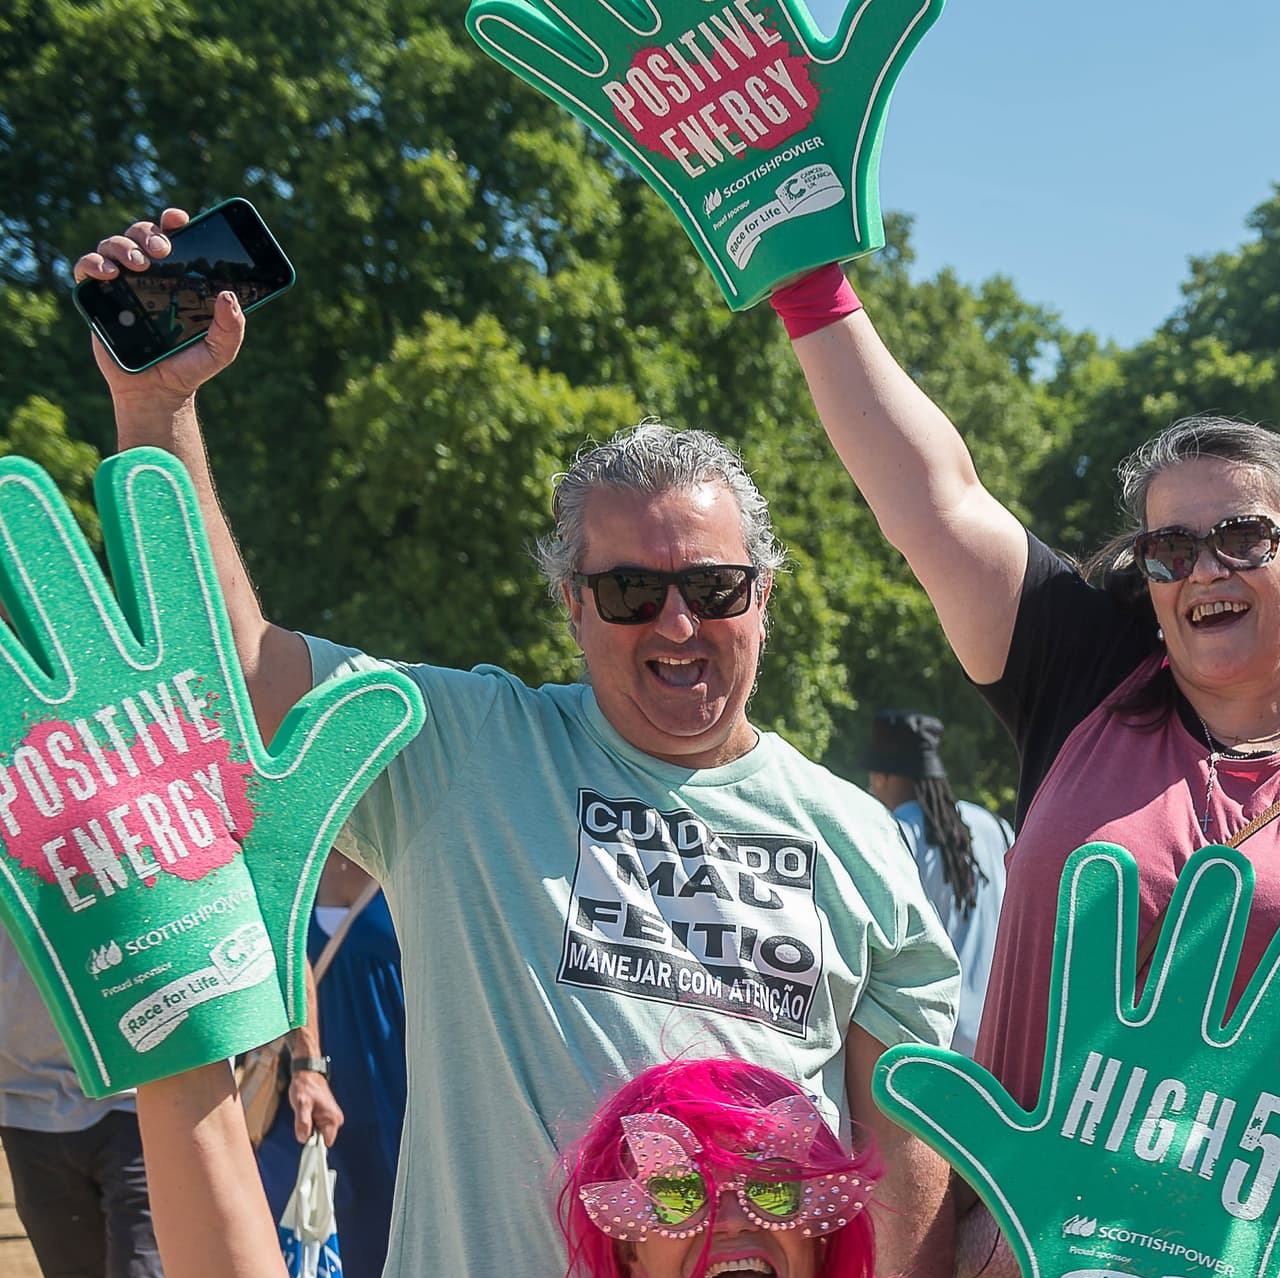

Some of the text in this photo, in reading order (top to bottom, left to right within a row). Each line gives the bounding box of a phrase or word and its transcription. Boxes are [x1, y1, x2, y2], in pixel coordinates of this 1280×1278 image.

[602, 0, 782, 132] POSITIVE
[659, 58, 808, 178] ENERGY
[723, 136, 825, 198] SCOTTISHPOWER
[729, 206, 782, 256] Race for Life
[0, 669, 224, 837] POSITIVE
[41, 761, 238, 912] ENERGY
[616, 853, 785, 910] MAU
[125, 888, 257, 956] SCOTTISHPOWE
[575, 896, 816, 973] FEITIO
[101, 979, 132, 998] Proud
[127, 974, 220, 1035] Race for Life
[568, 942, 805, 1021] MANEJAR COM ATENÇÃO
[1060, 1050, 1236, 1180] HIGH
[1069, 1246, 1132, 1264] Proud sponsor
[1098, 1226, 1236, 1278] SCOTTISHPOWER
